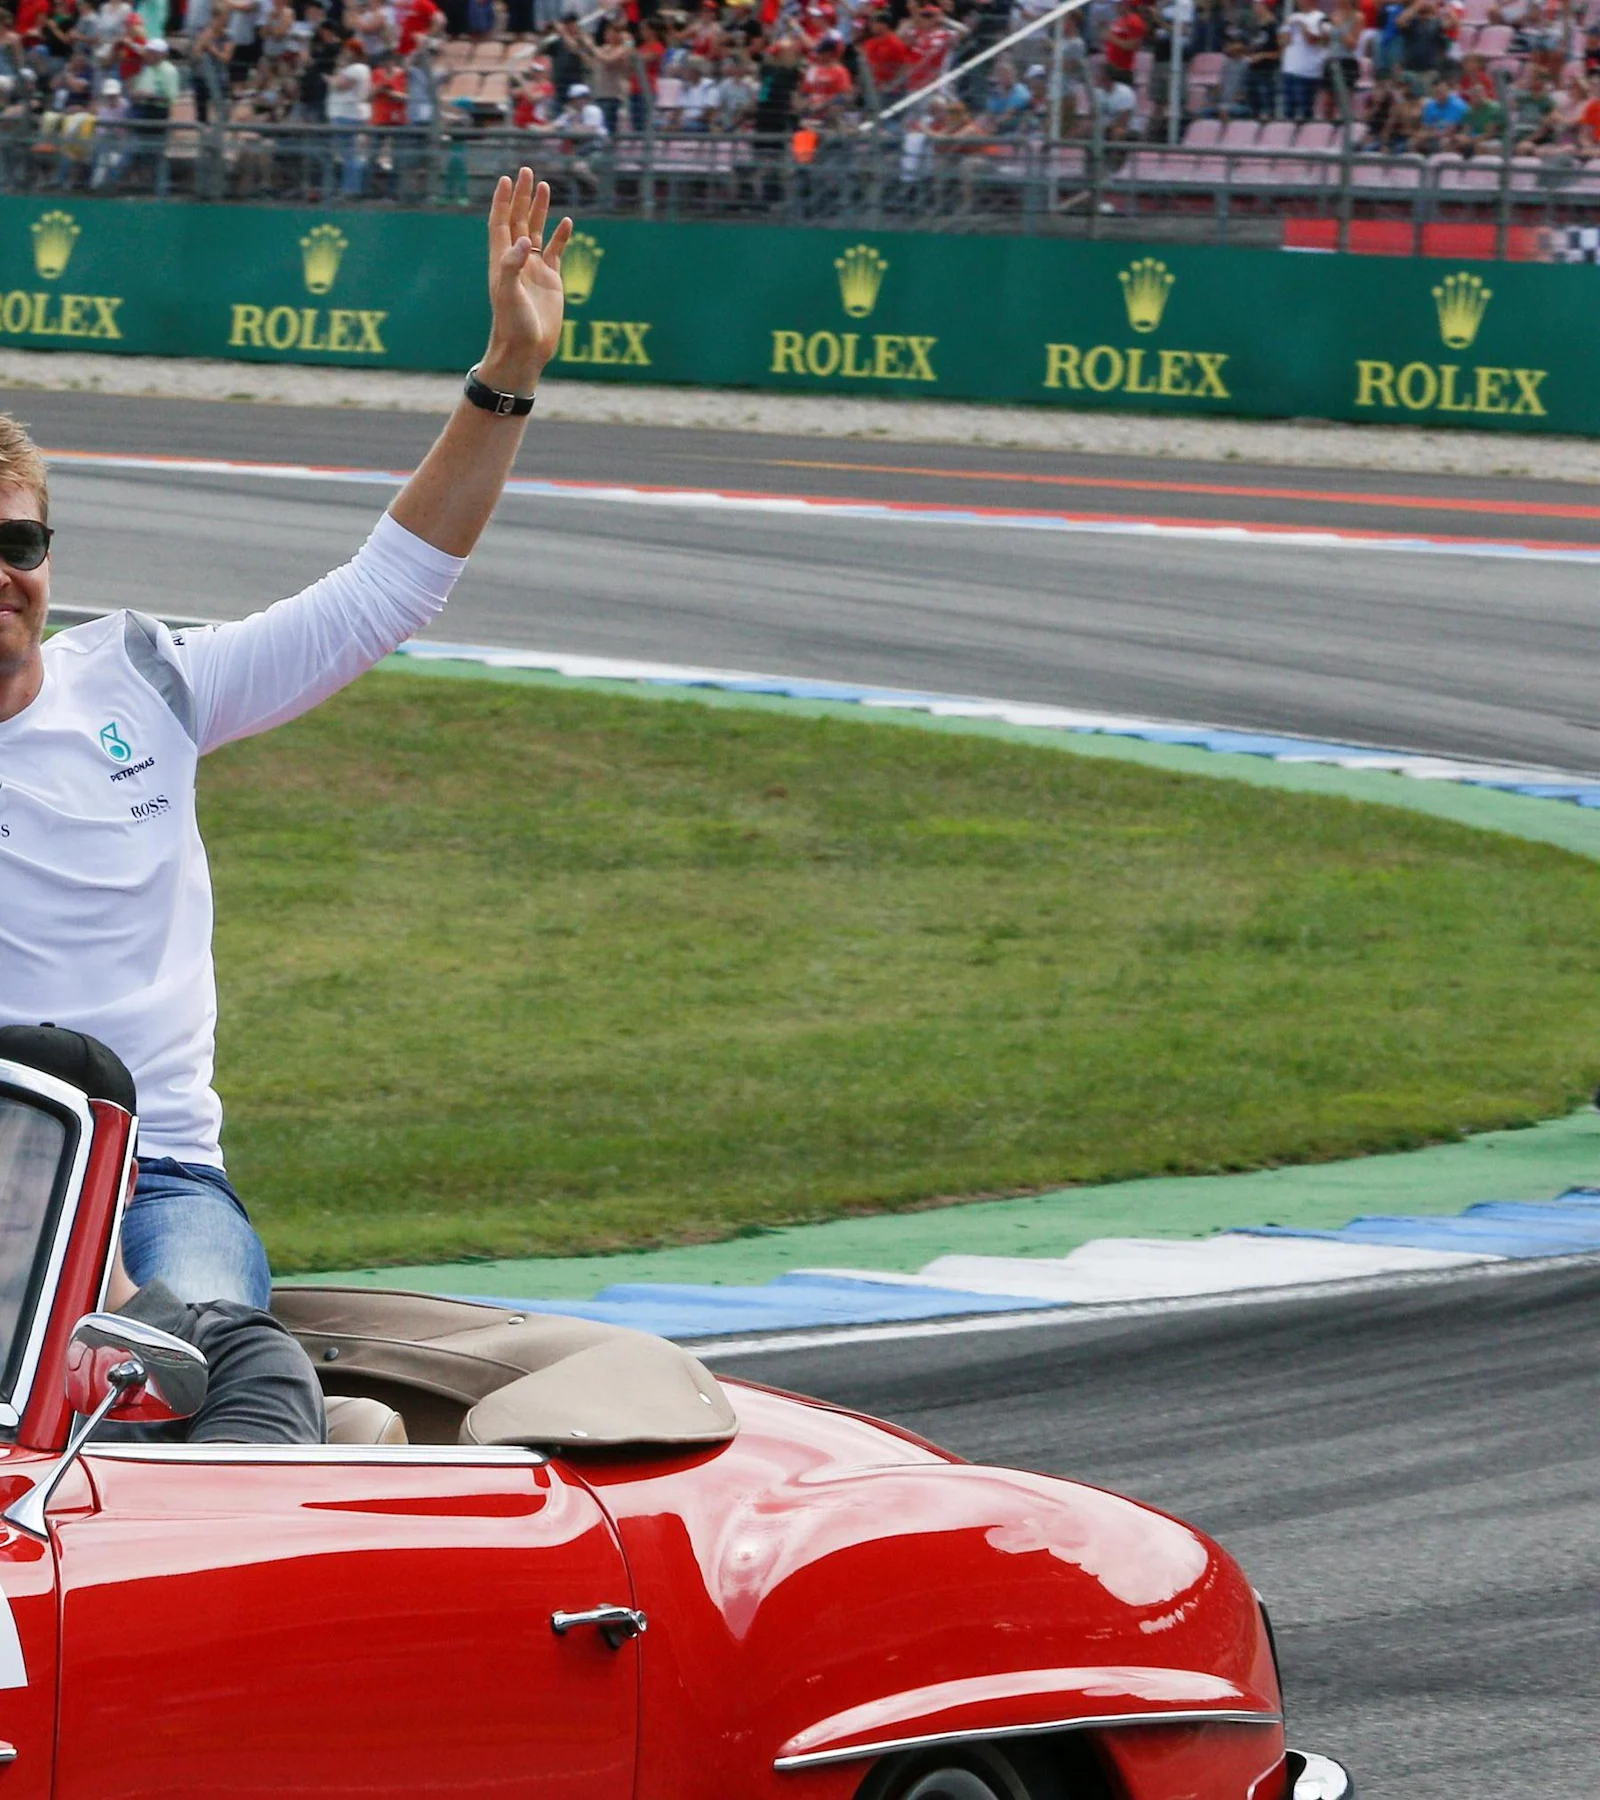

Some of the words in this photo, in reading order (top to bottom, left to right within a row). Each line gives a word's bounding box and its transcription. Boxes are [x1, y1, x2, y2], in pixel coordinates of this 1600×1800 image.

[228, 304, 386, 353] ROLEX
[555, 320, 652, 366] LEX
[770, 330, 938, 381] ROLEX
[1044, 343, 1231, 398] ROLEX
[1354, 360, 1548, 416] ROLEX
[110, 757, 155, 782] PETRONAS
[131, 794, 169, 819] BOSS
